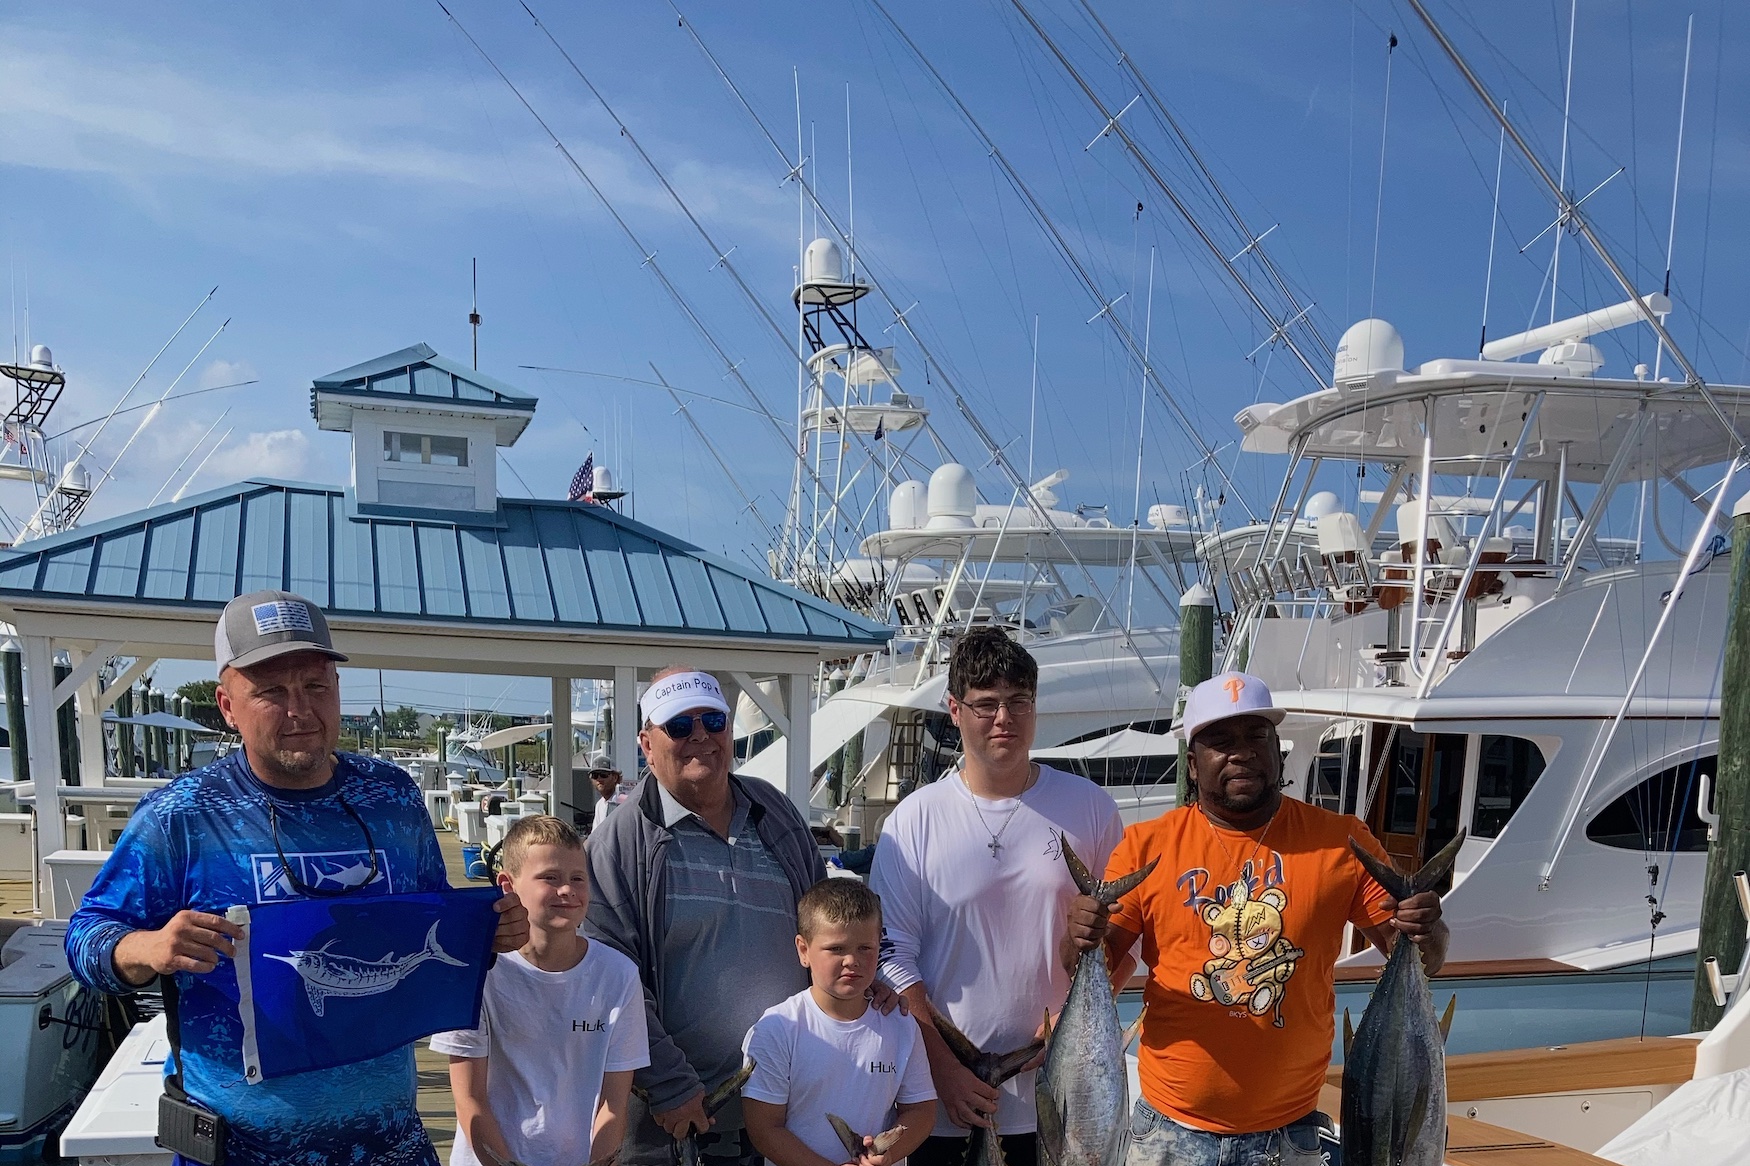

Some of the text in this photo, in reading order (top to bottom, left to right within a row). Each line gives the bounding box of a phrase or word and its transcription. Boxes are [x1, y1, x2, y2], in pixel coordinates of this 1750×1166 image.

[655, 679, 692, 700] Captain
[693, 678, 713, 691] Pop
[1223, 678, 1246, 703] P
